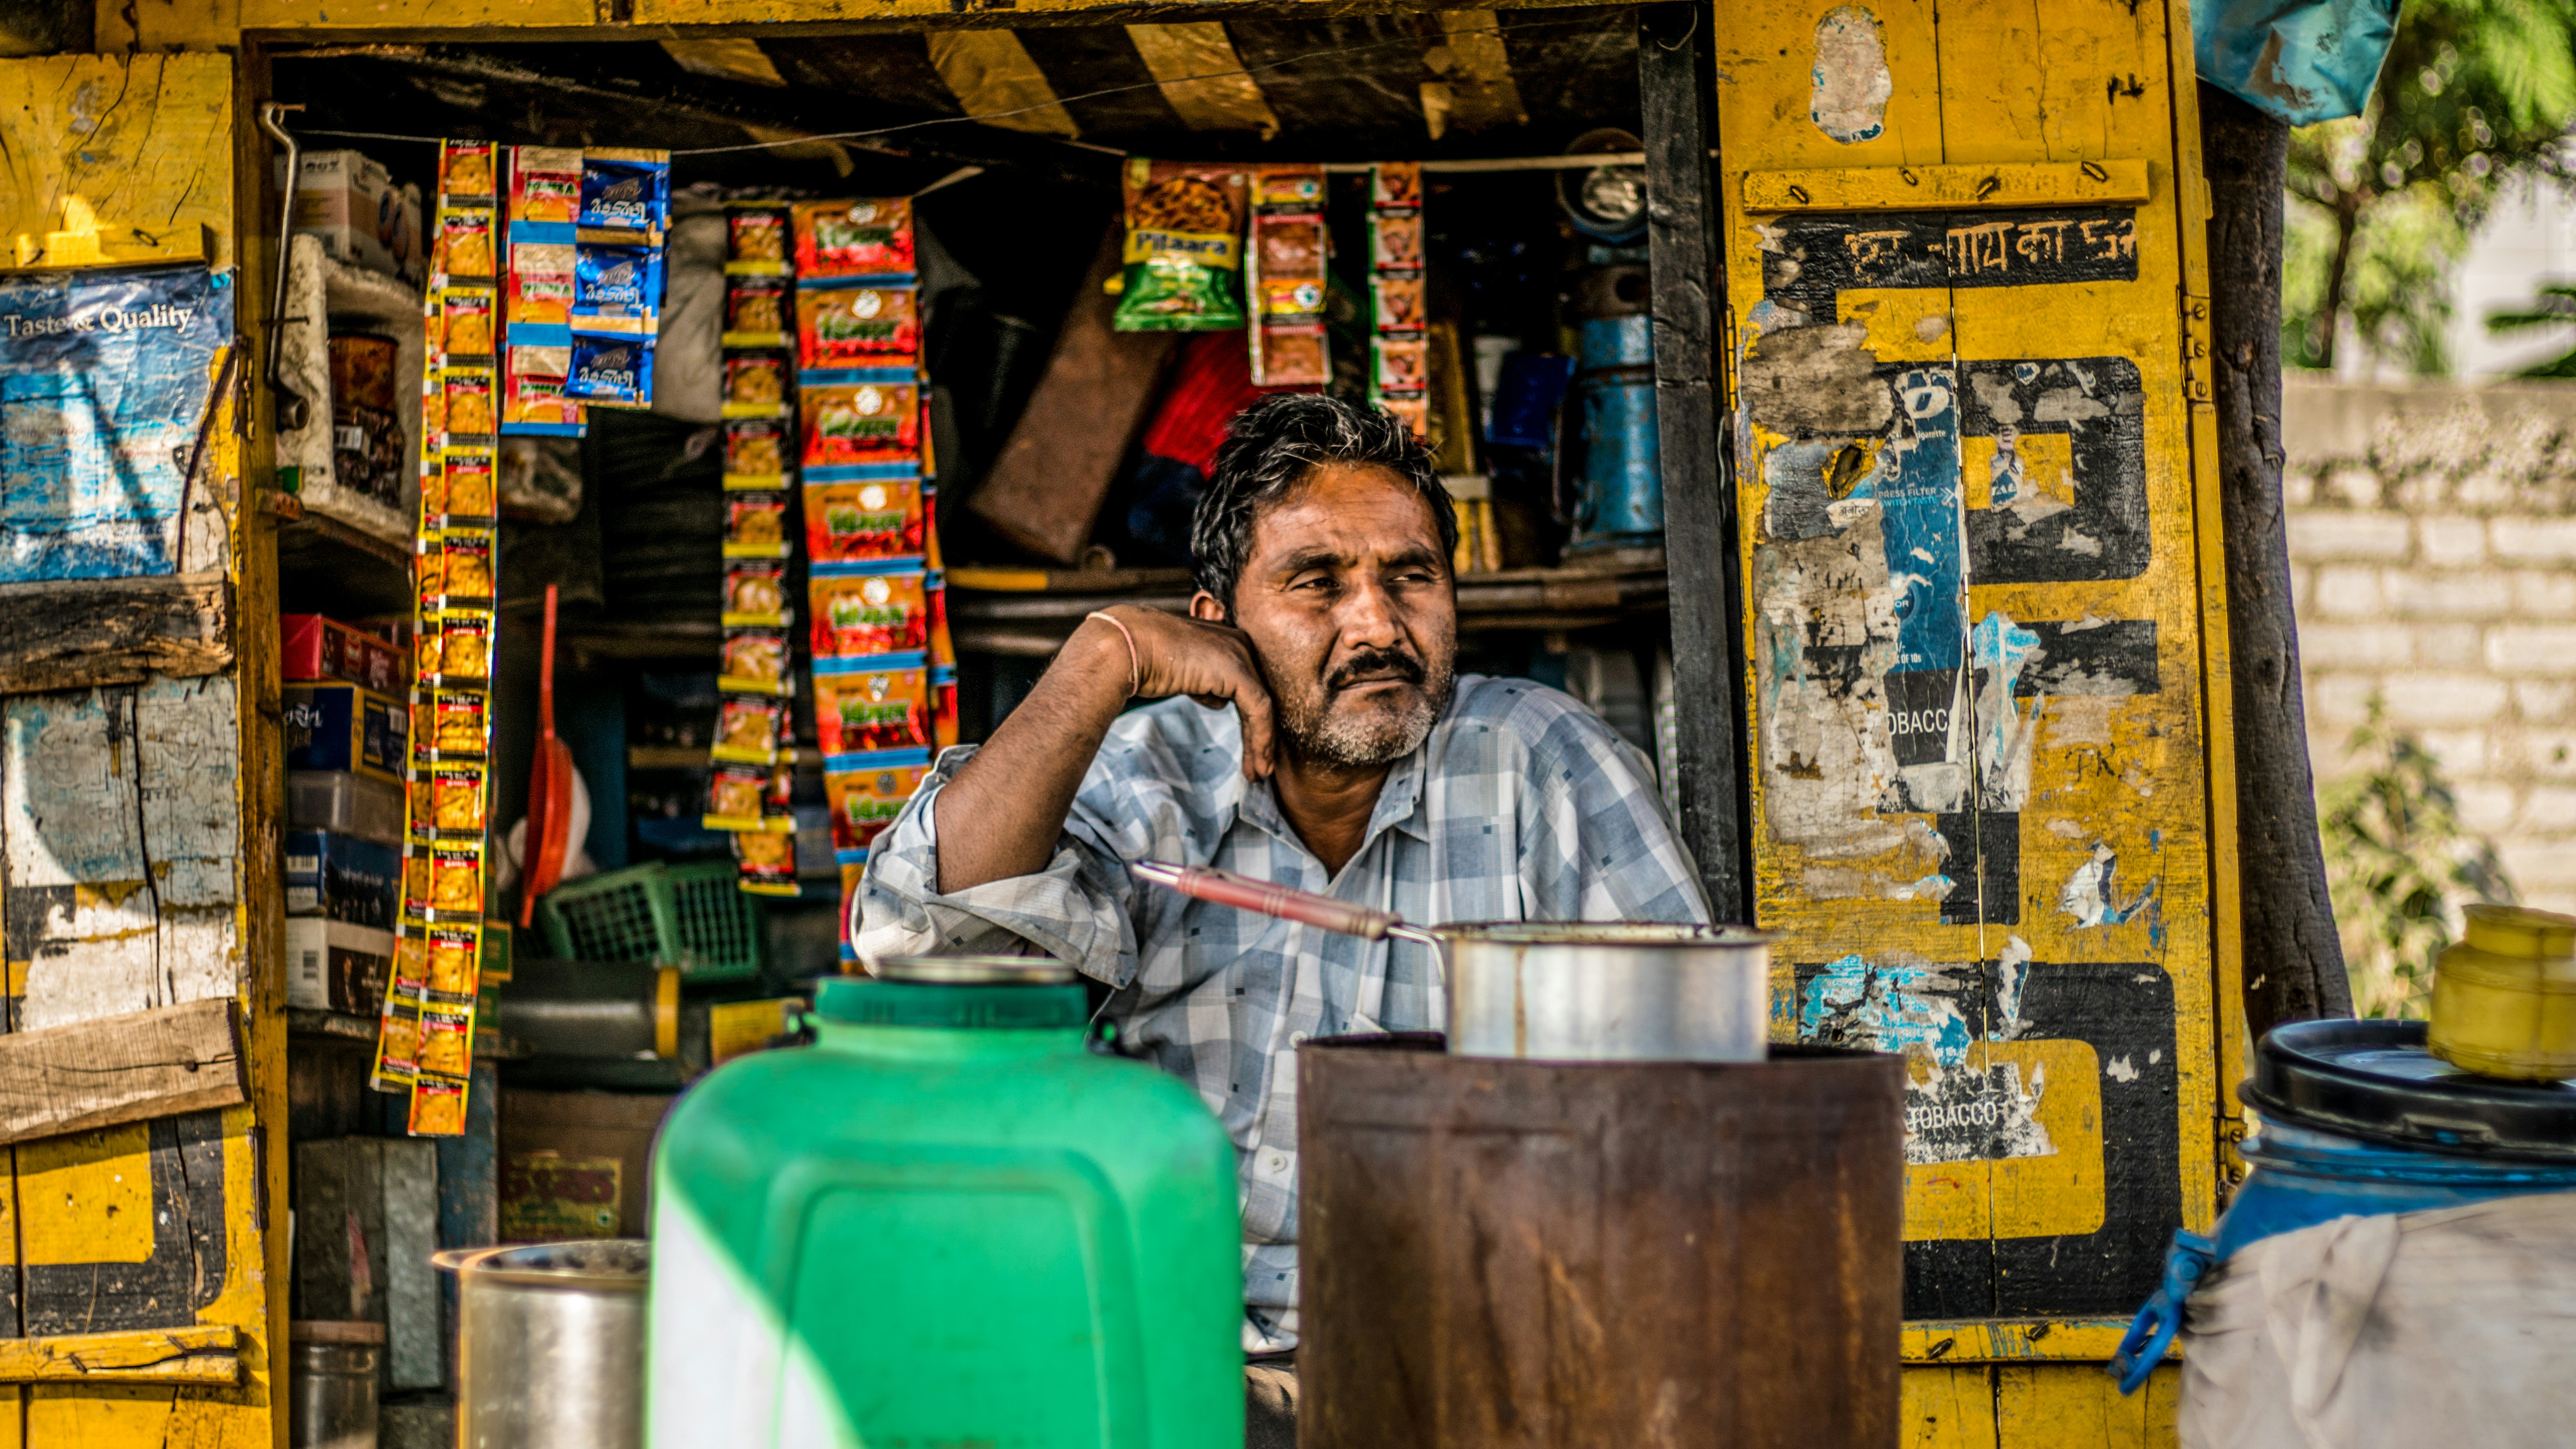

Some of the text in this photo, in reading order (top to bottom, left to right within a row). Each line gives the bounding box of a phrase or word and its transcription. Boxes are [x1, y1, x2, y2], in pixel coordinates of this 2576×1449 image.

[3, 304, 192, 336] Taste & Quality
[1878, 486, 1937, 498] PRESS FILTER
[1901, 655, 1909, 664] OF
[1911, 653, 1921, 663] 10s
[1888, 709, 1950, 736] OBACC
[1907, 1101, 1997, 1131] TOBACCO
